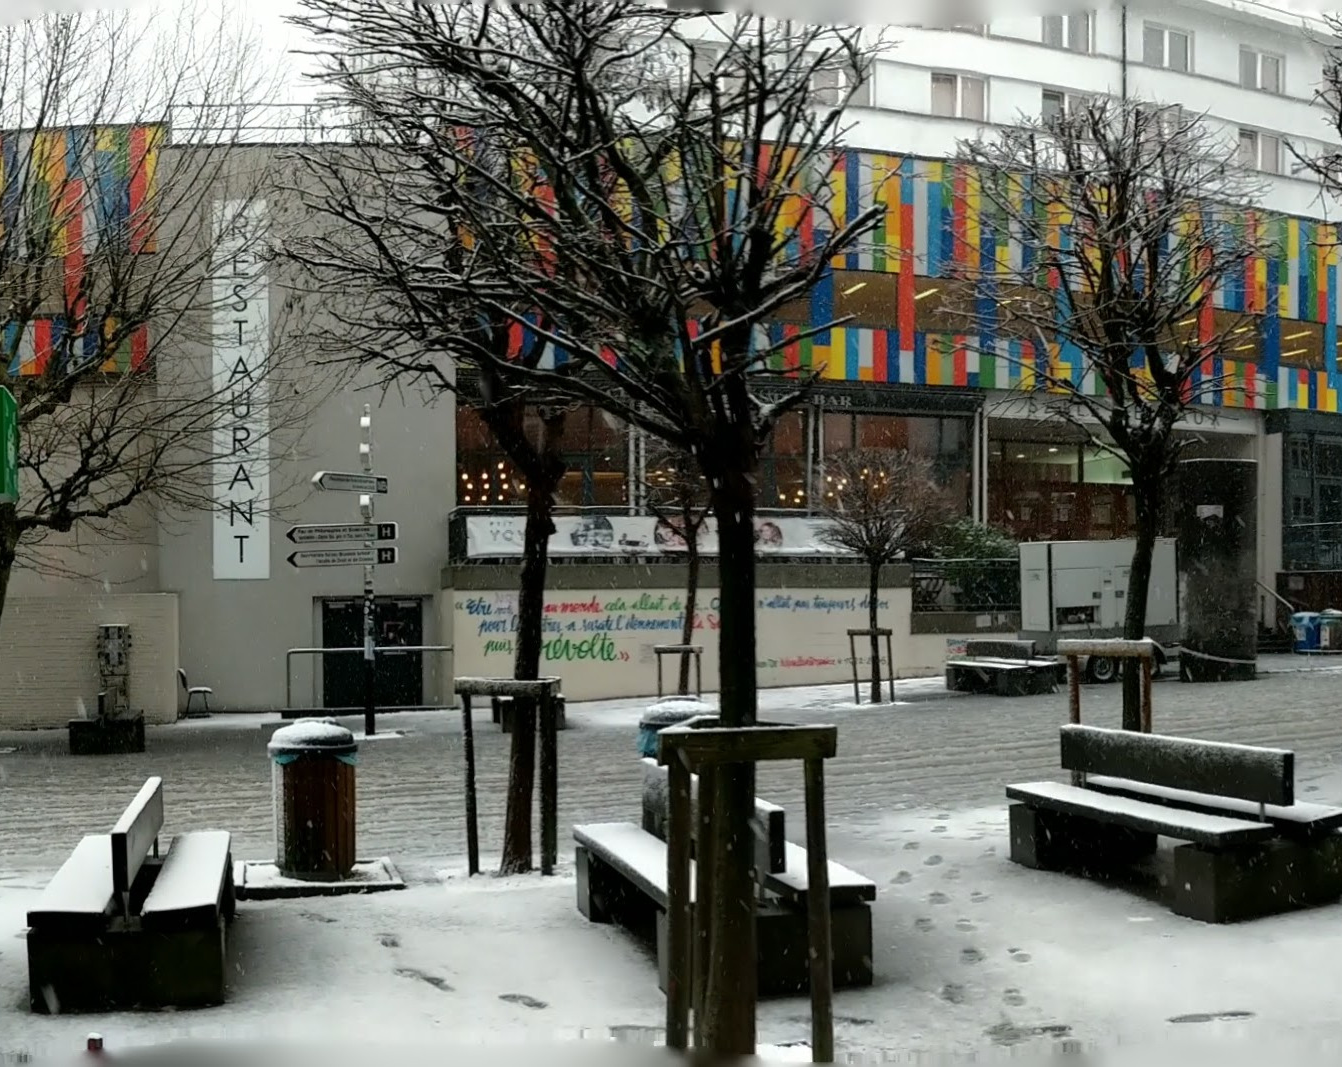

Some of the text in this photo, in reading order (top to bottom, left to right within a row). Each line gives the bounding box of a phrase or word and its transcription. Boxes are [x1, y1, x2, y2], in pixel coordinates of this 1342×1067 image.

[227, 214, 255, 564] RESTAURANT
[814, 394, 852, 406] BAR
[381, 527, 391, 537] H
[381, 551, 392, 561] H
